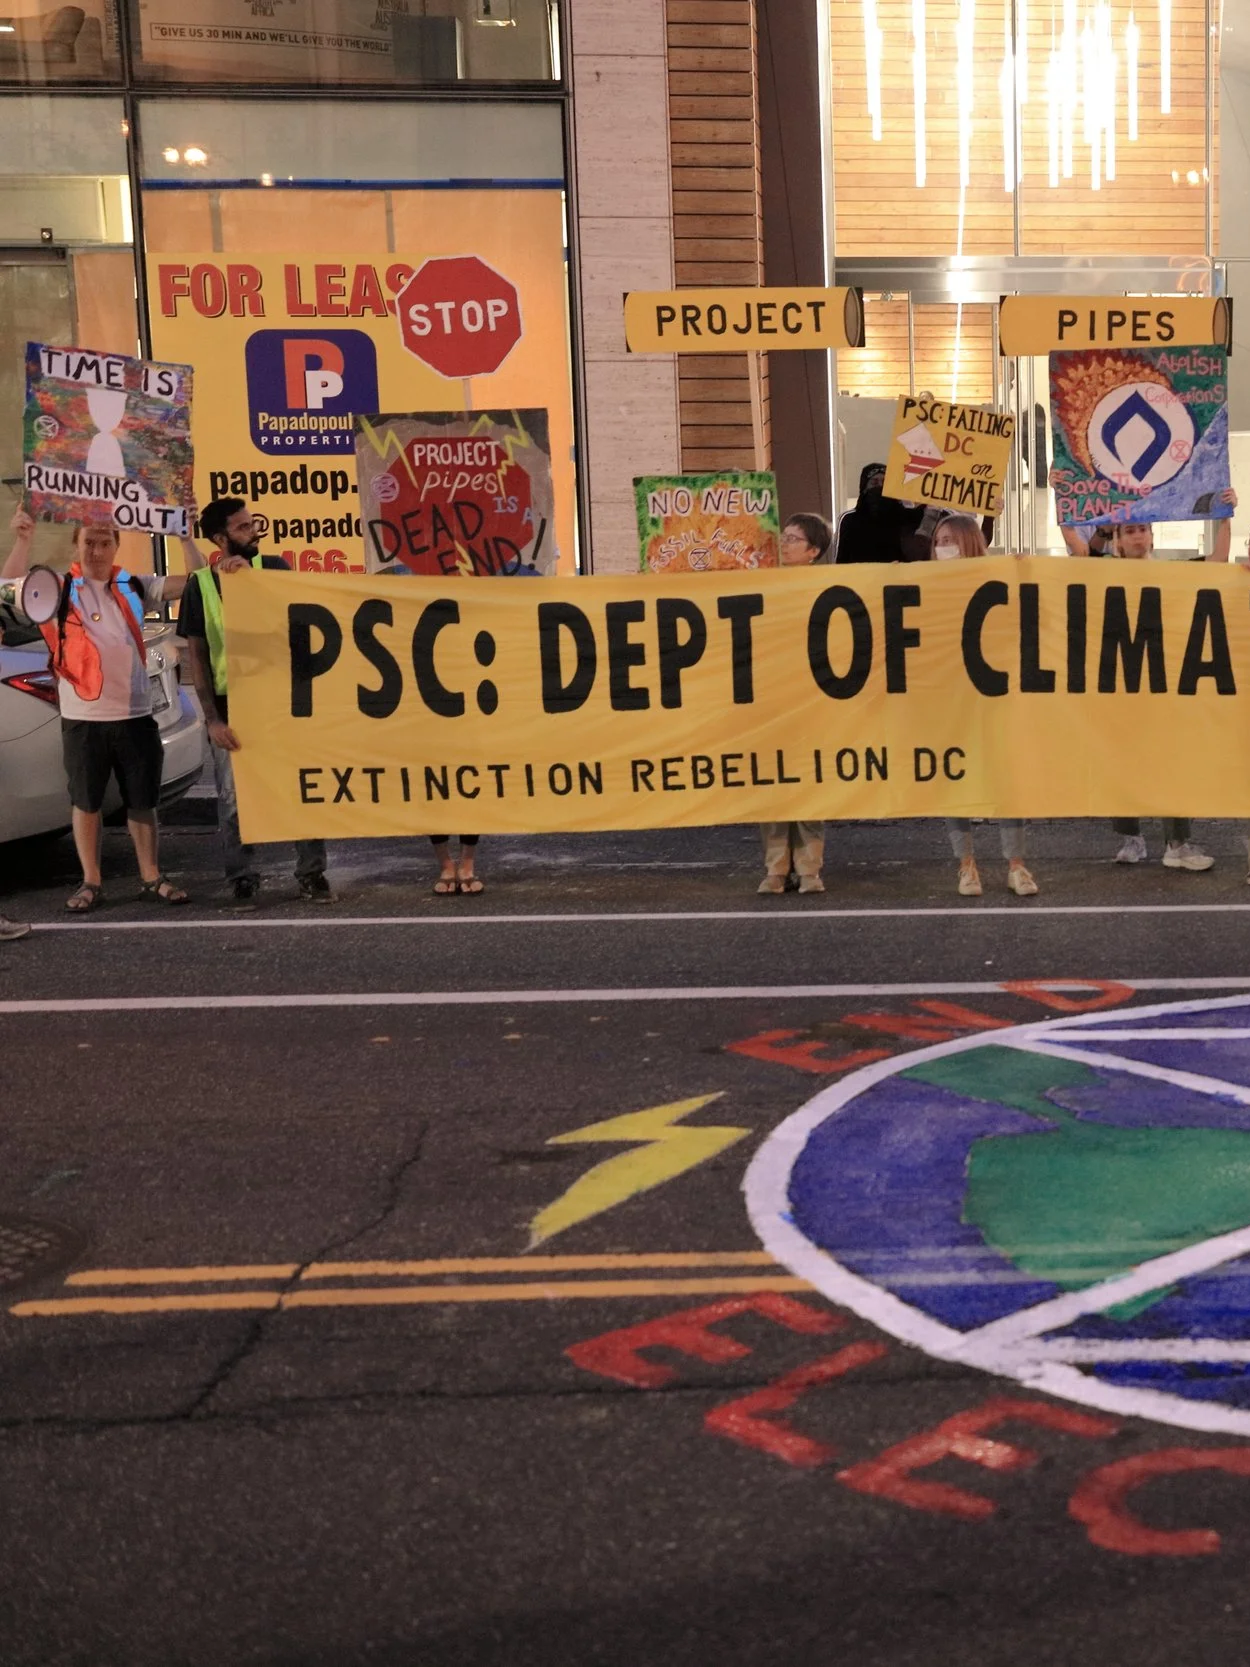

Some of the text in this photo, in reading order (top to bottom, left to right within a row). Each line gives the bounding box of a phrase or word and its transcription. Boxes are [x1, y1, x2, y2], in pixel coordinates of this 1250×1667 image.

[189, 28, 204, 38] US
[206, 29, 220, 39] 30
[222, 30, 242, 40] MIN
[245, 32, 267, 42] AND
[269, 33, 300, 44] WE'LL
[302, 35, 325, 46] GIVE
[326, 37, 343, 47] YOU
[344, 39, 362, 49] THE
[158, 263, 266, 317] FOR
[409, 299, 509, 336] STOP
[656, 302, 826, 336] PROJECT
[1058, 309, 1175, 341] PIPES
[42, 350, 174, 396] TIME IS
[947, 405, 1013, 438] FAILING
[261, 436, 350, 445] PROPERTI
[413, 441, 501, 466] PROJECT
[944, 432, 975, 456] DC
[28, 465, 140, 502] RUNNING
[420, 471, 499, 503] pipes
[971, 463, 996, 479] on
[1112, 472, 1152, 496] The
[492, 496, 519, 513] IS
[650, 488, 771, 516] NO NEW
[921, 472, 999, 511] CLIMATE
[521, 508, 535, 524] A
[1058, 497, 1136, 525] PLANET
[368, 501, 484, 563] DEAD
[287, 597, 499, 718] PSC:
[537, 593, 765, 714] DEPT
[807, 584, 921, 699] OF
[300, 746, 966, 804] EXTINCTION REBELLION DC
[725, 976, 1136, 1074] END
